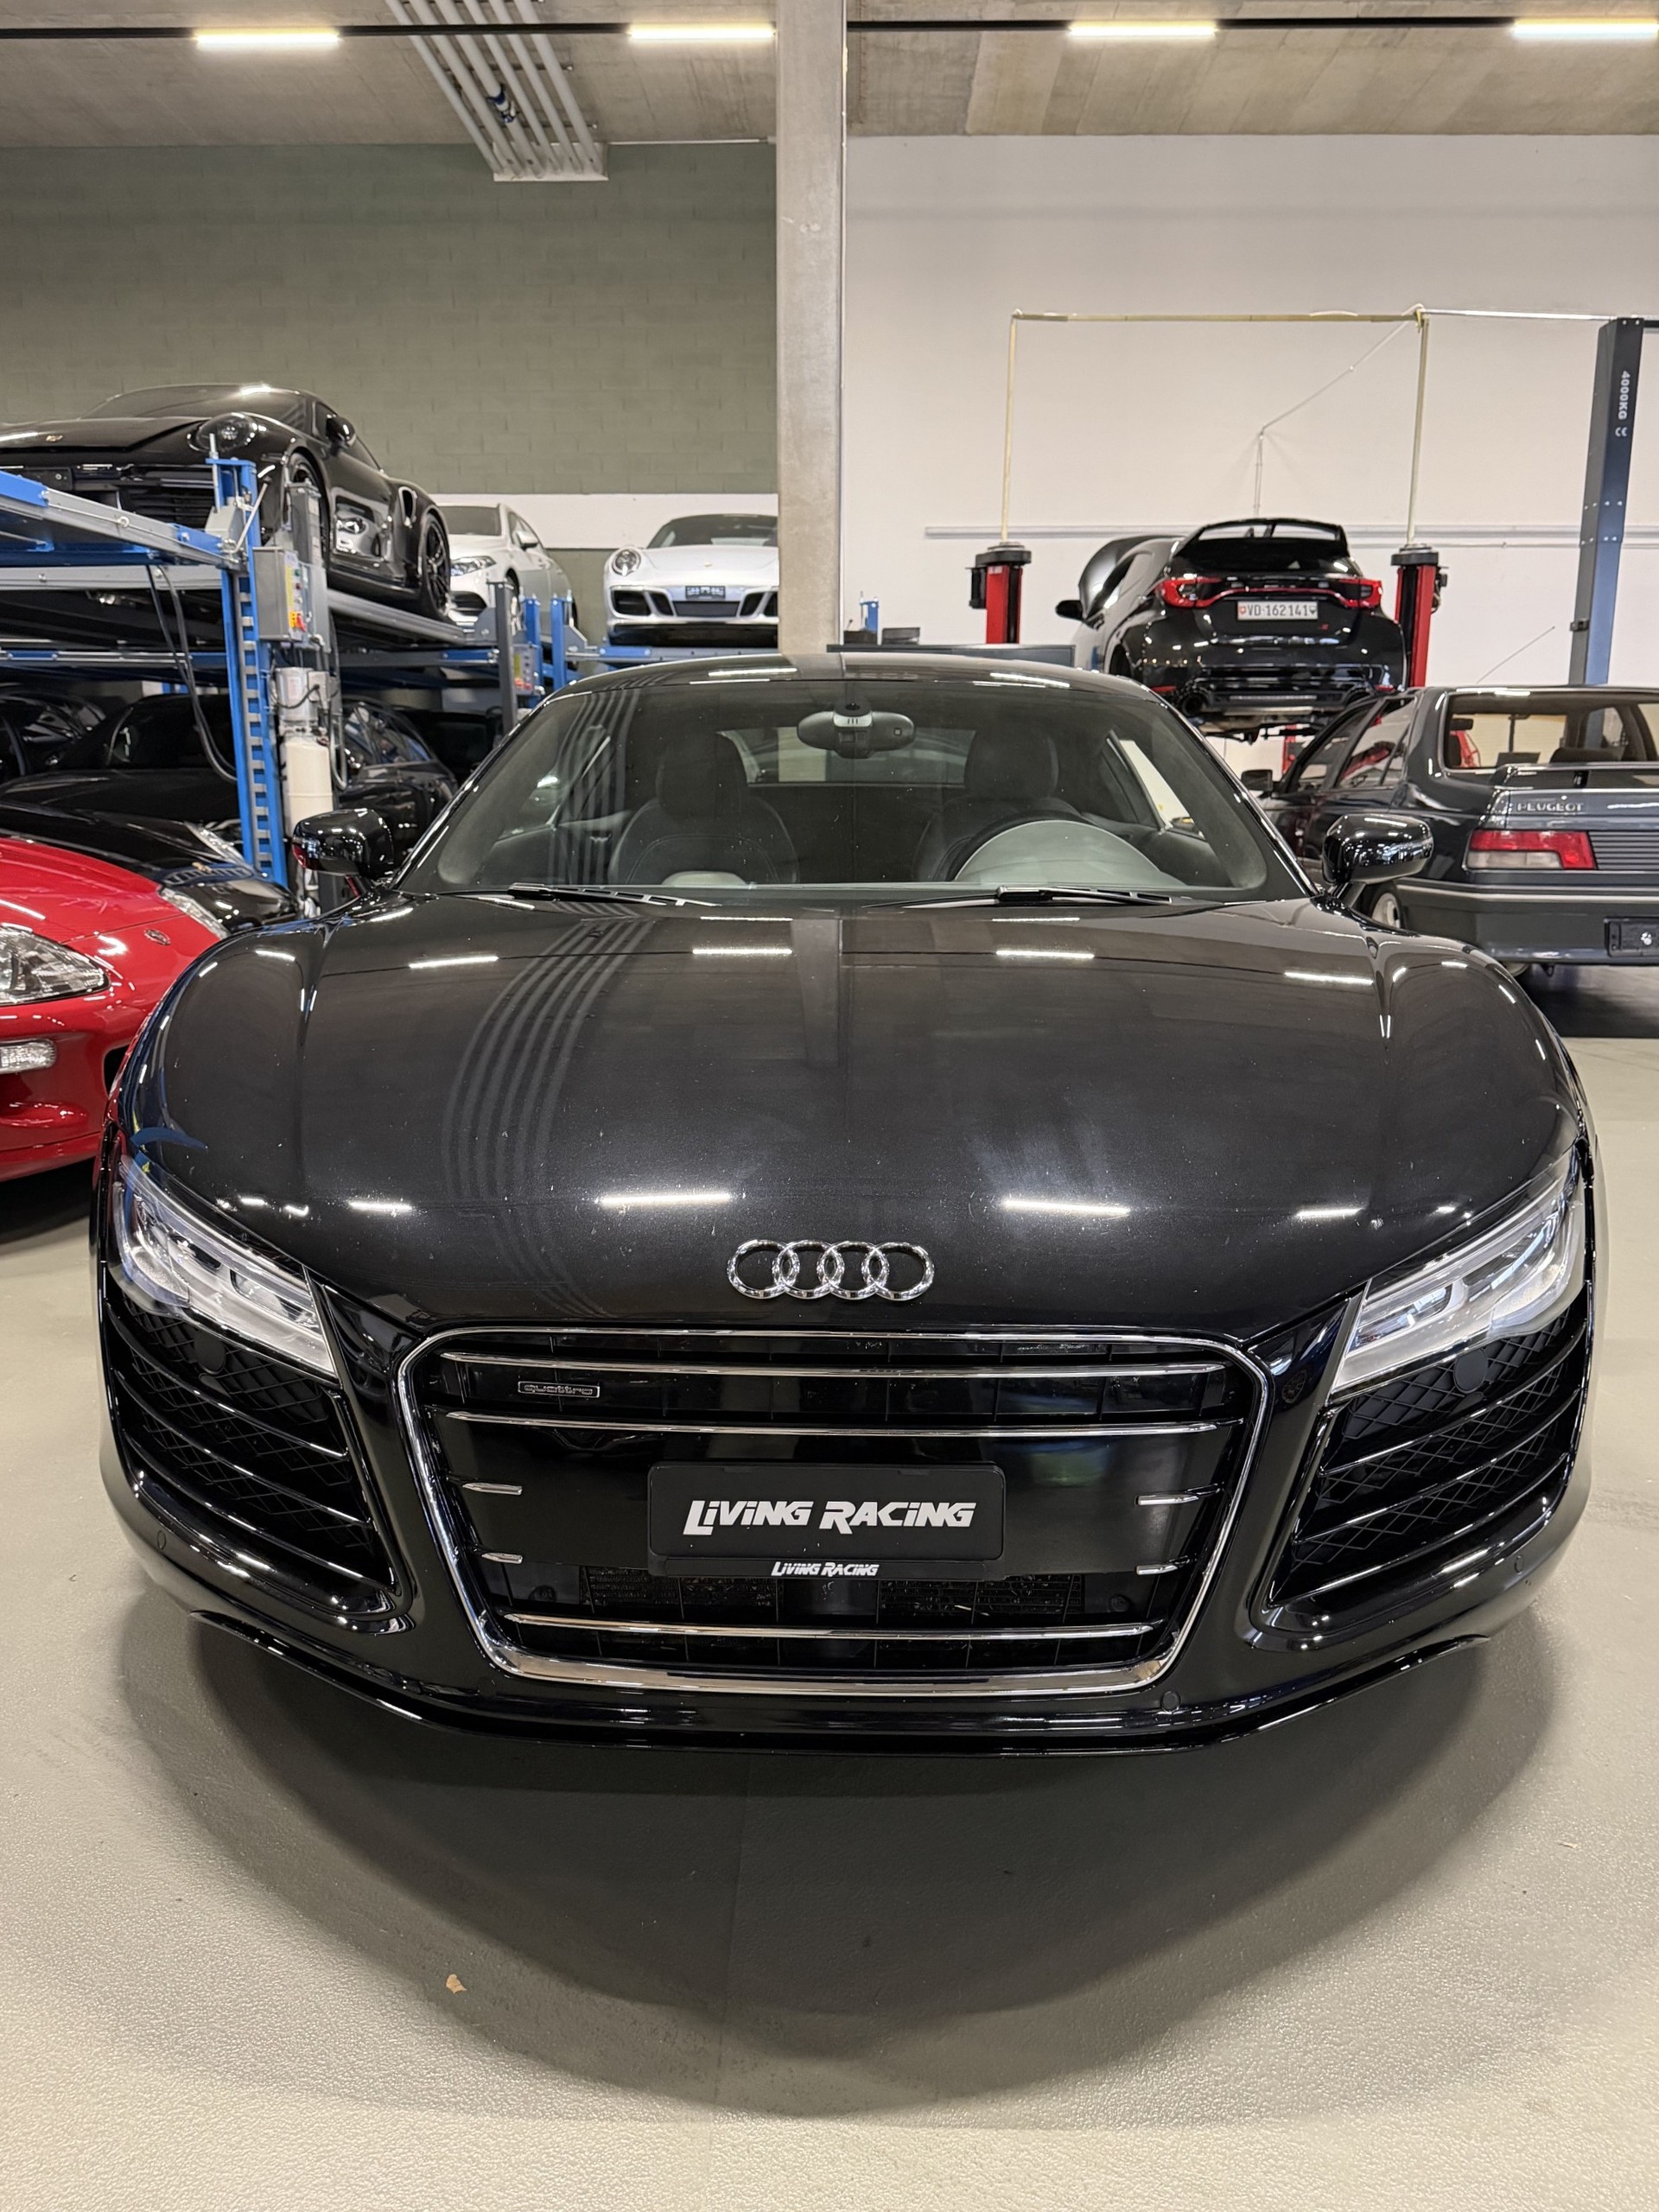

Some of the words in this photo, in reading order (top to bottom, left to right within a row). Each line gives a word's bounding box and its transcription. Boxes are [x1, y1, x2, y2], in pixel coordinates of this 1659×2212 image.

[1618, 371, 1630, 420] 4000KG
[1517, 803, 1584, 811] PEUGEOT
[524, 1385, 593, 1395] quattro
